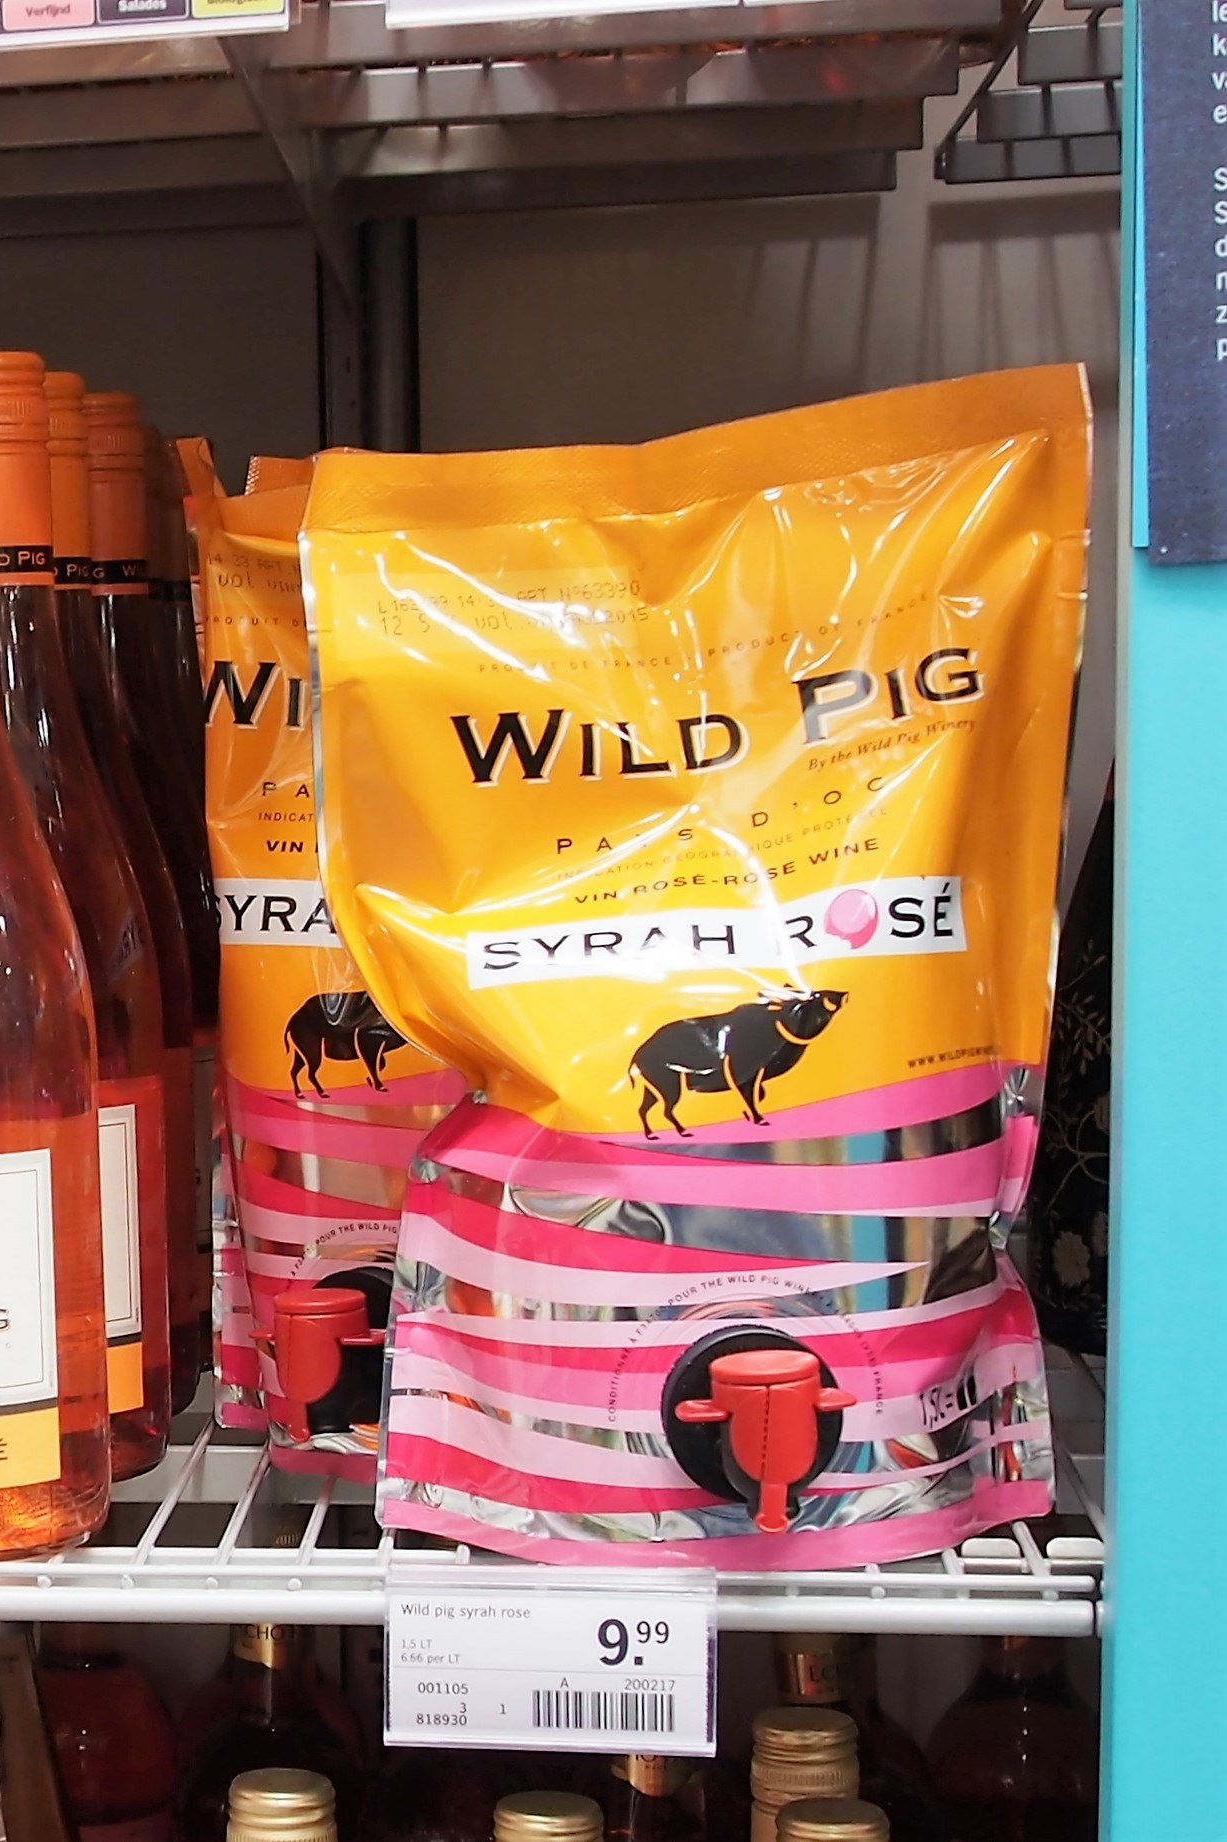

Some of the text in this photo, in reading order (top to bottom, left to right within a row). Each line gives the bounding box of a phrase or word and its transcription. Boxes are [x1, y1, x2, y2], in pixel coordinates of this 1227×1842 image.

[17, 551, 46, 565] PIG
[857, 592, 928, 628] FRANCE
[205, 660, 306, 729] WI
[450, 646, 985, 788] WILD PIG
[808, 718, 977, 771] By the Wild Pig Winery
[266, 840, 304, 854] VIN
[556, 828, 694, 855] PAS
[575, 890, 619, 905] VIN
[809, 837, 880, 866] WINE
[215, 894, 339, 934] YRA
[483, 882, 955, 971] SYRAH ROSÉ
[316, 1222, 398, 1247] POUR THE WILD PIG
[668, 1286, 697, 1306] POUR
[700, 1277, 724, 1291] THE
[727, 1274, 757, 1285] WILD
[760, 1274, 780, 1286] PIG
[401, 1603, 531, 1619] Wild pig syrah rose
[420, 1639, 433, 1649] LT
[597, 1618, 670, 1667] 9.99
[400, 1652, 461, 1666] 6.66 per LT
[418, 1682, 469, 1695] 001105
[560, 1677, 676, 1692] A 200217
[416, 1713, 468, 1727] 818930
[460, 1702, 507, 1715] 3 1
